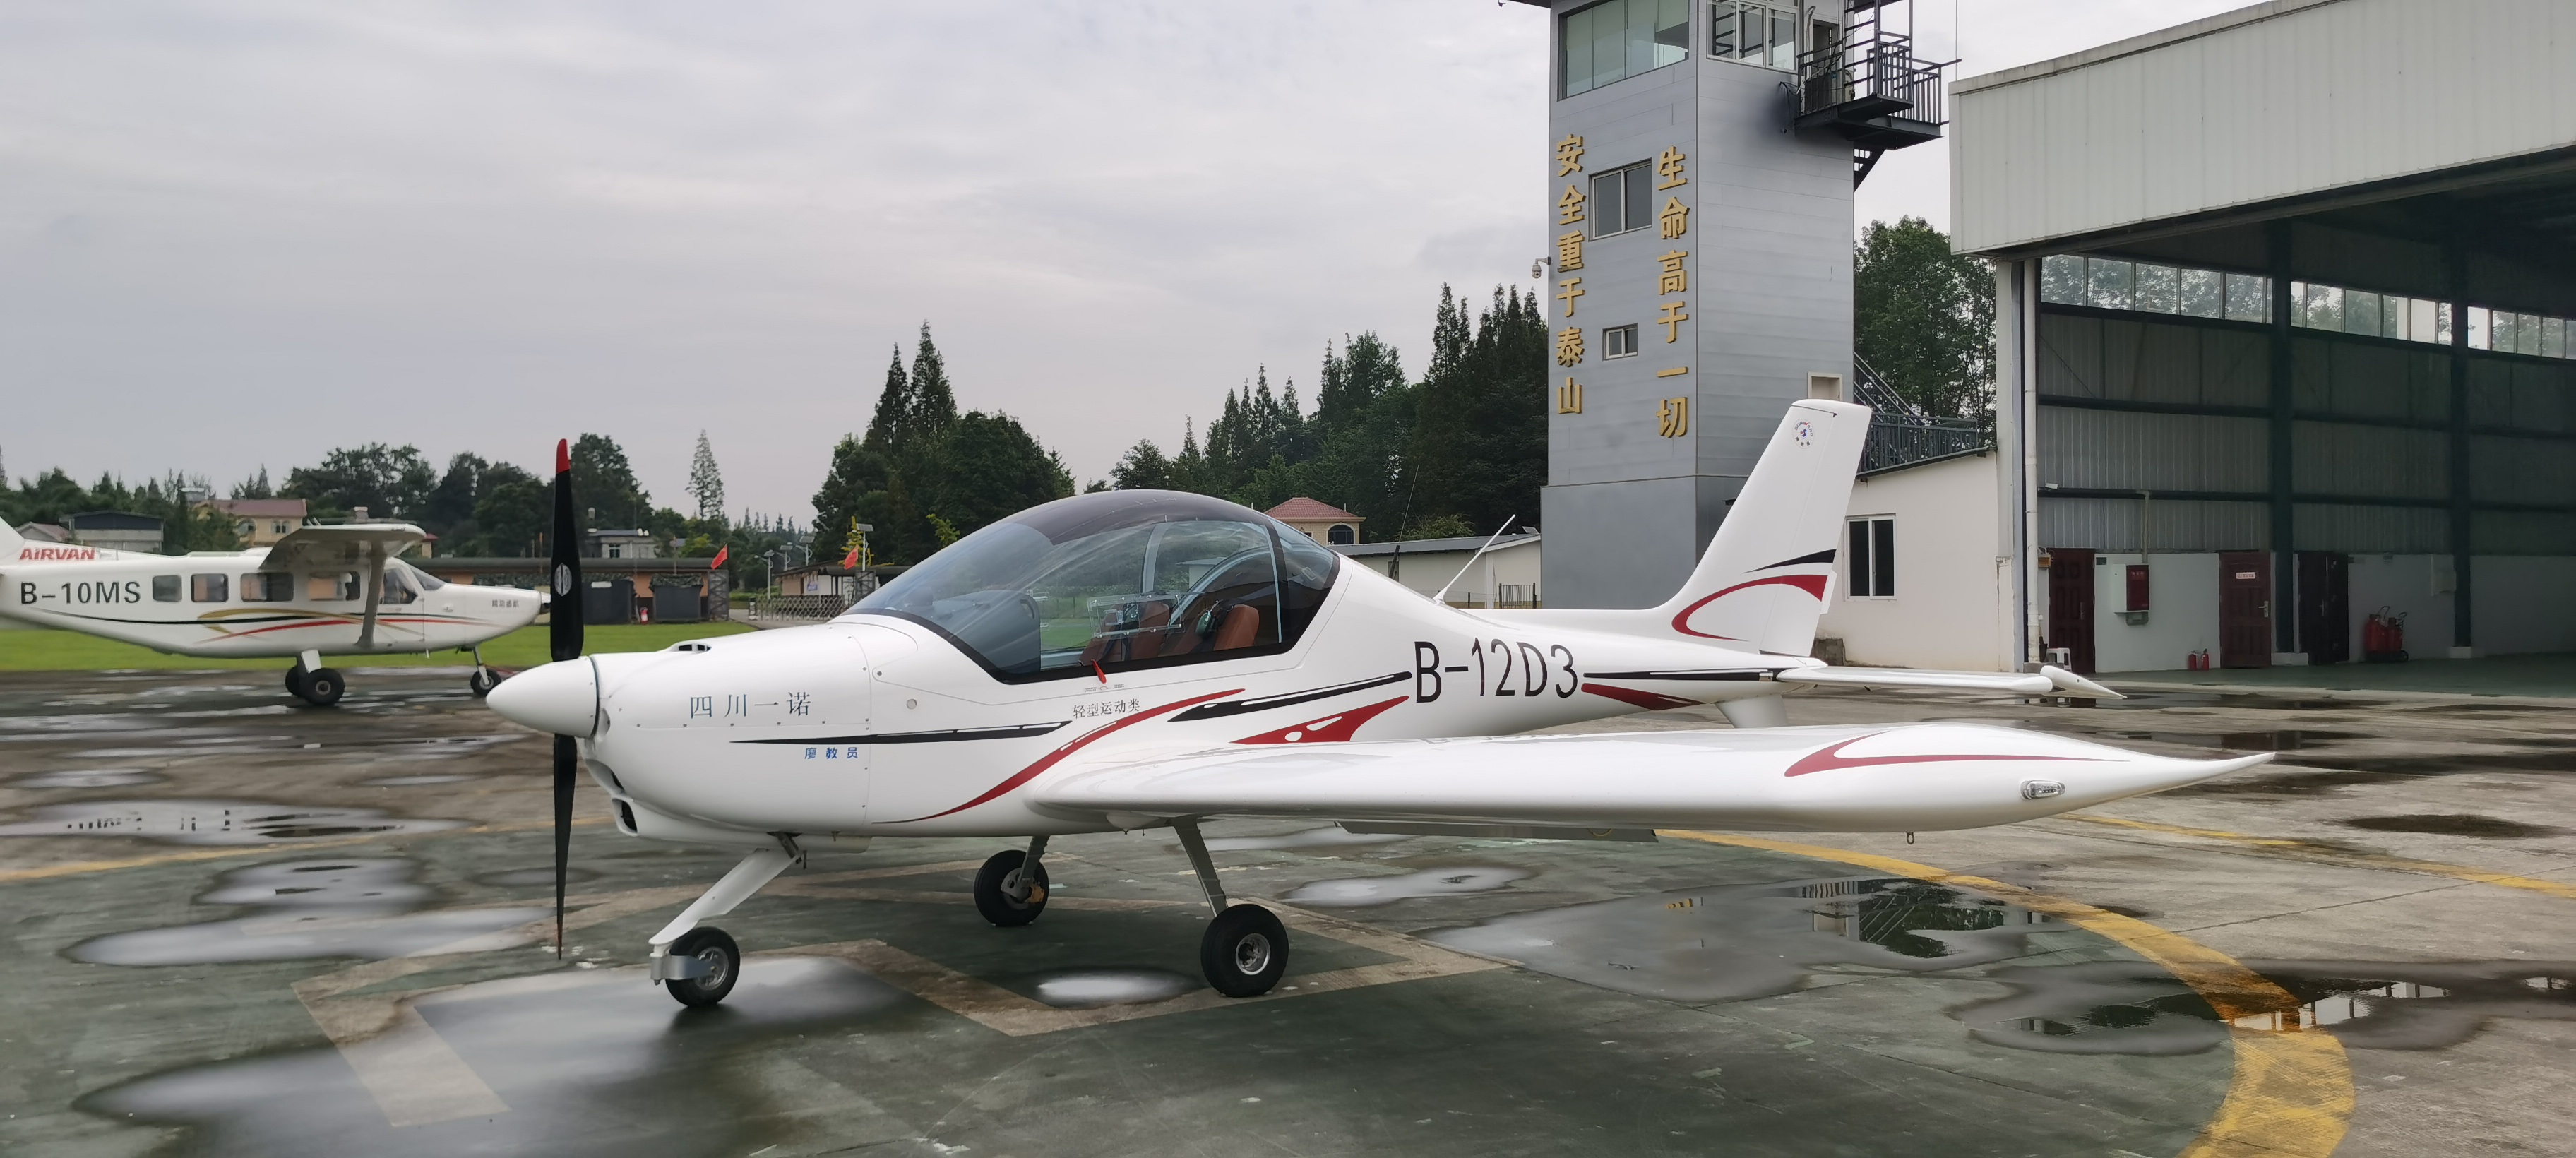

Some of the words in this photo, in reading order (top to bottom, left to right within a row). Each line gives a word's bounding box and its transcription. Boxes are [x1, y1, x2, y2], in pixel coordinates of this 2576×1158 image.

[1556, 133, 1585, 414] 安全重于泰山
[1656, 145, 1690, 438] 生命高于一切
[19, 547, 96, 561] AIRVAN
[20, 581, 141, 604] B-10MS
[1414, 638, 1578, 703] B-12D3
[690, 691, 811, 719] 四川一诺
[1073, 698, 1140, 719] 轻型运动类
[804, 746, 859, 760] 廖教员
